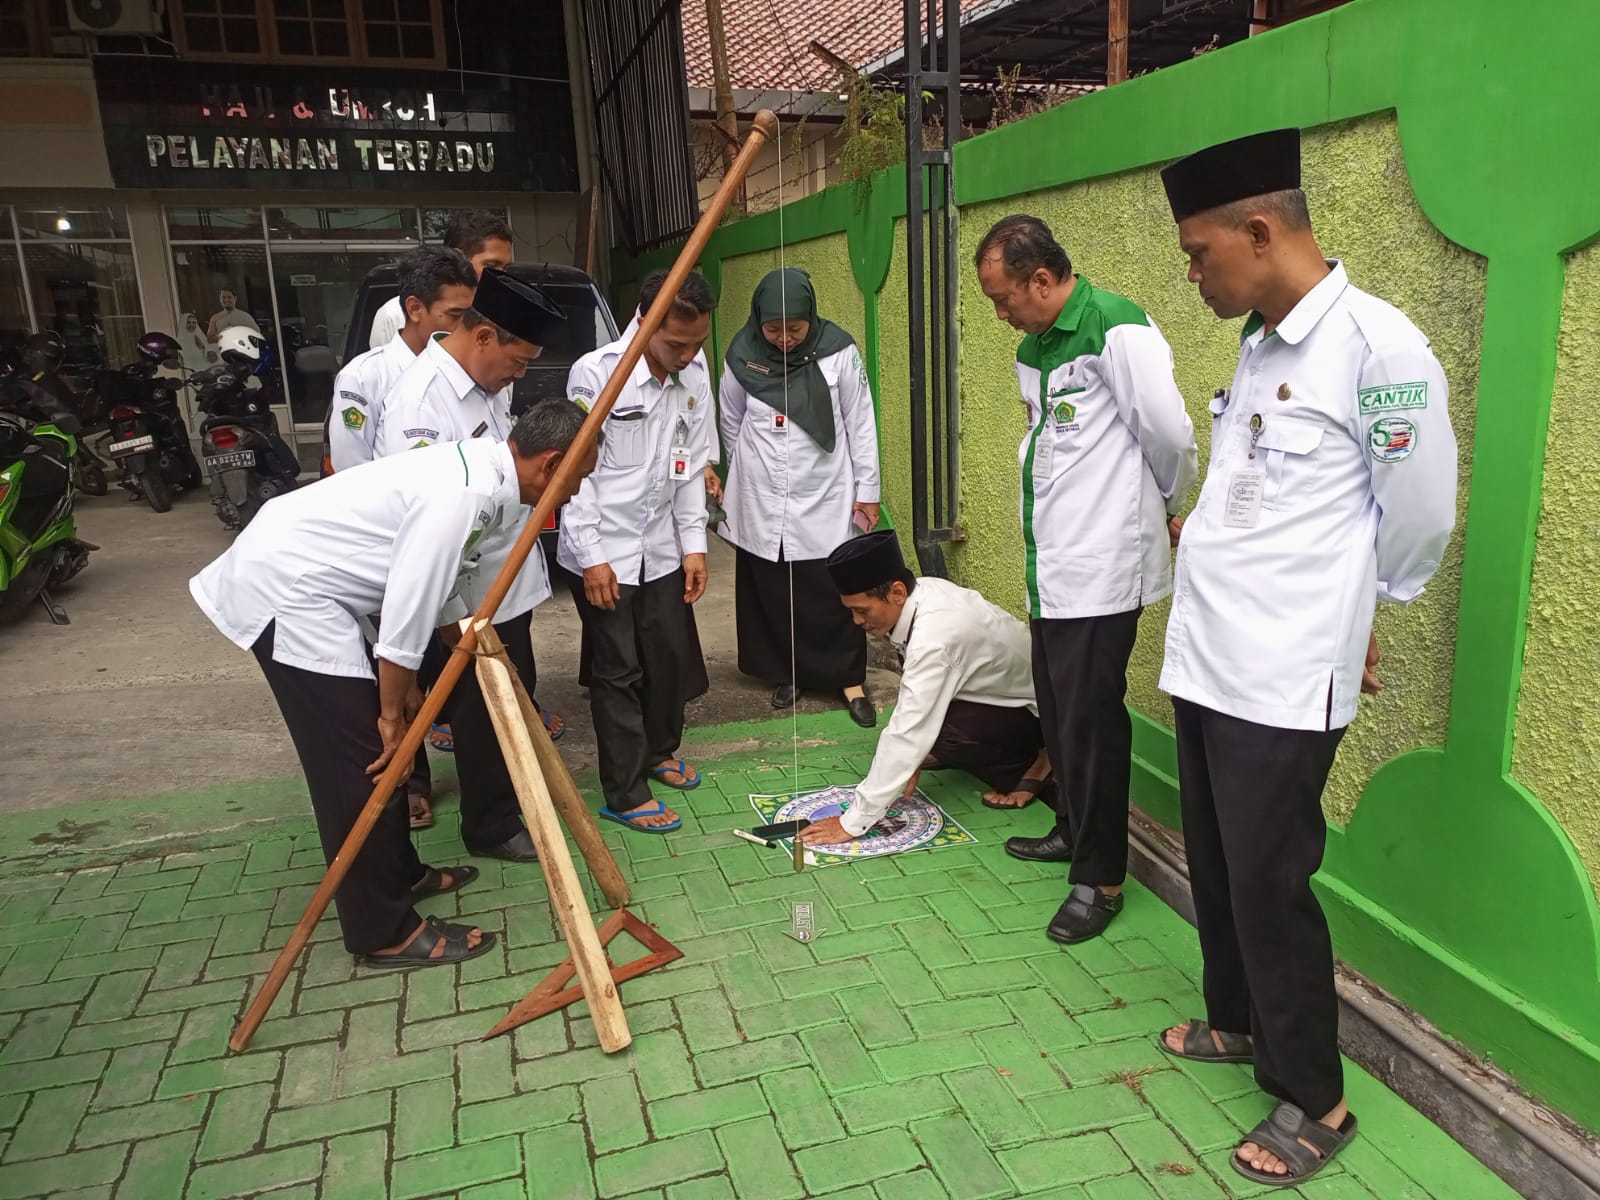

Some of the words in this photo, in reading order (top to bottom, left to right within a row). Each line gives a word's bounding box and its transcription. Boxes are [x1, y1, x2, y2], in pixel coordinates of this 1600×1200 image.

[146, 134, 339, 171] PELAYANAN
[354, 139, 494, 173] TERPADU
[1361, 389, 1423, 407] CANTIK
